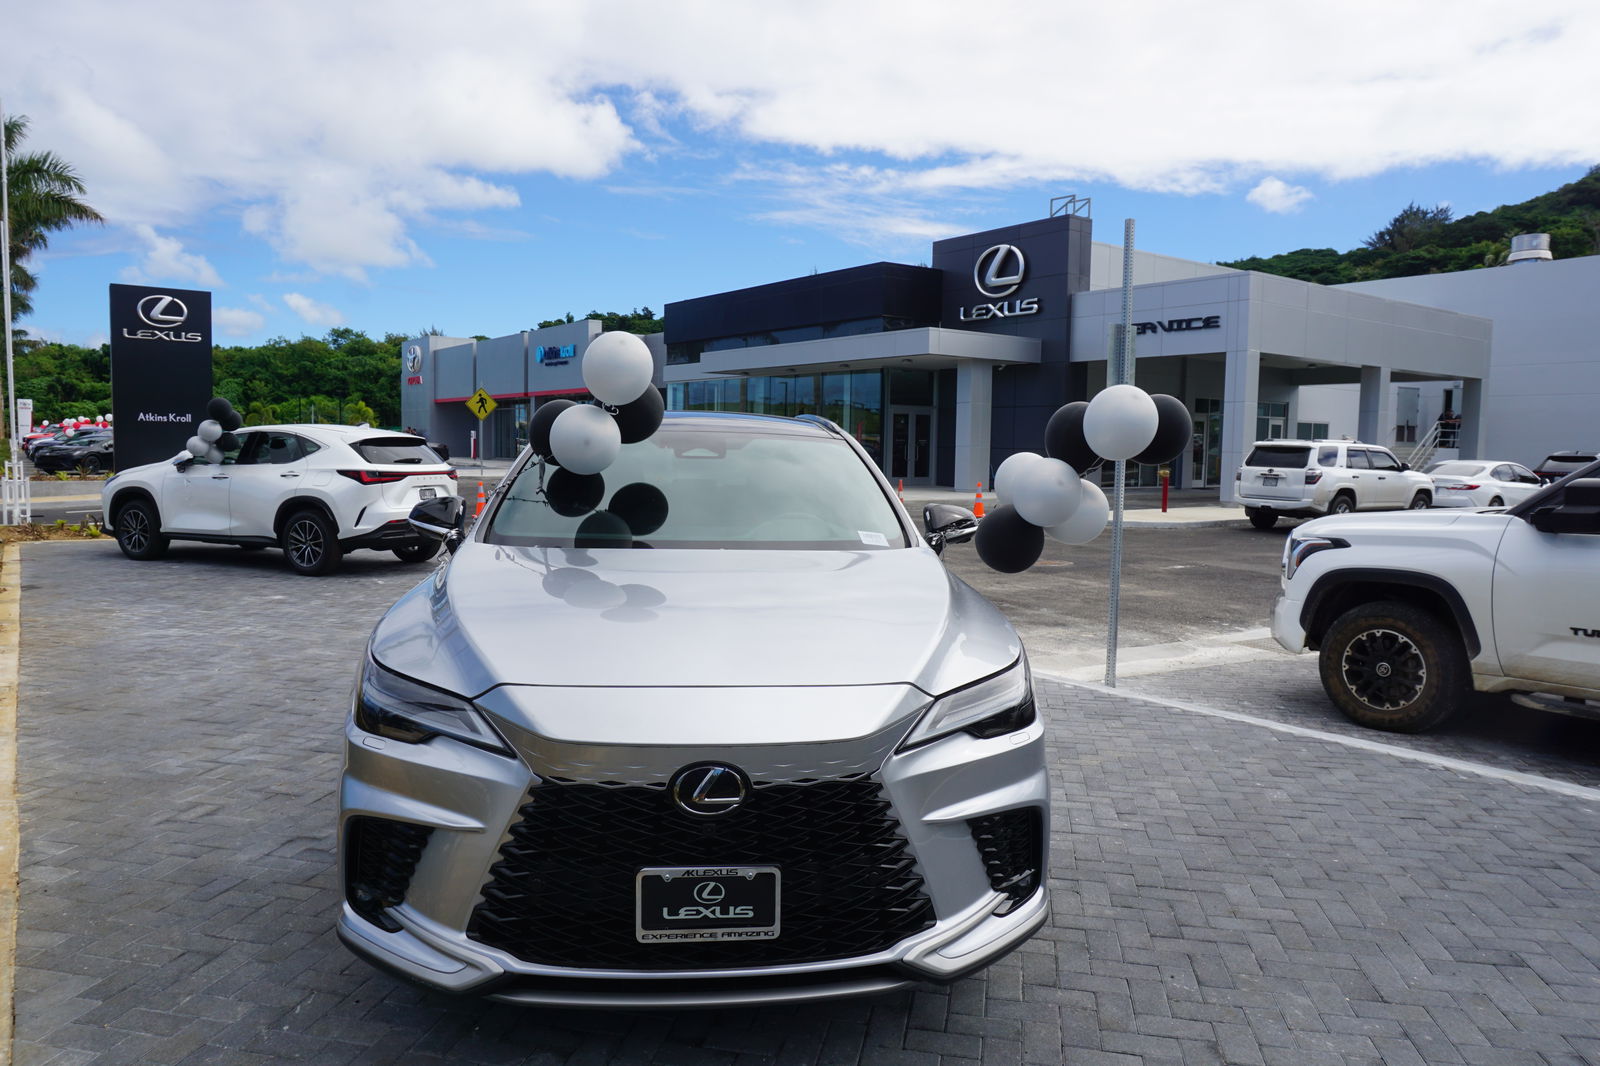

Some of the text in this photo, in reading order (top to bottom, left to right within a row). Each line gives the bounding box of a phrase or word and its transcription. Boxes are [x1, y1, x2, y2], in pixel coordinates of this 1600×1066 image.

[959, 297, 1039, 322] LEXUS
[122, 328, 202, 343] LEXUS
[137, 411, 192, 423] Atkins Kroll
[662, 905, 754, 920] LEXUS
[641, 930, 775, 940] EXPERIENCE AMAZING
